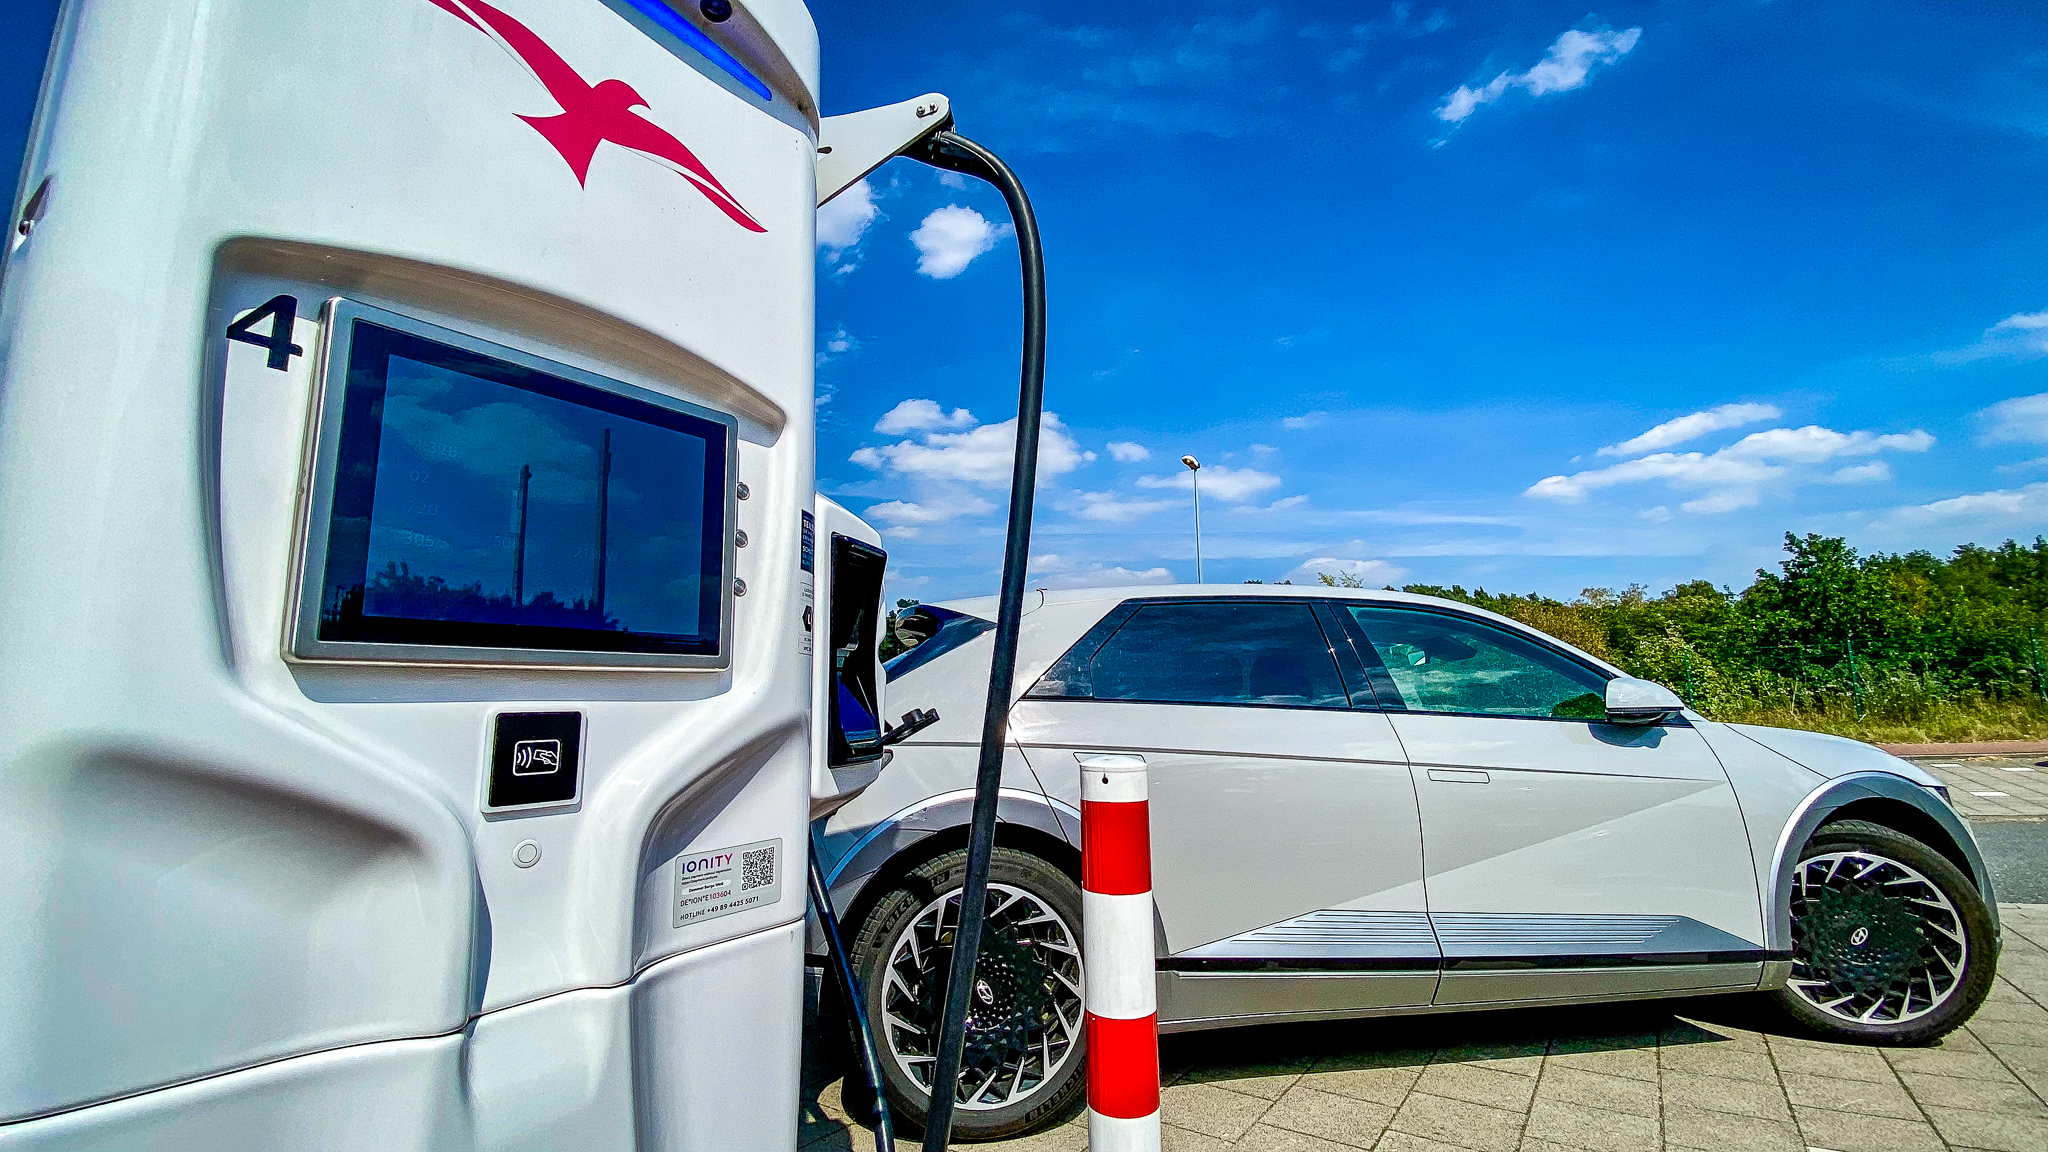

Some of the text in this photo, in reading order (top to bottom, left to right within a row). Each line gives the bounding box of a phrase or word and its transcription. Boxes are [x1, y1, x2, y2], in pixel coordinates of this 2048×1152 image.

[226, 294, 303, 372] 4
[681, 853, 733, 875] IONITY
[680, 895, 759, 921] HOTLINE +49 89 4425 5071
